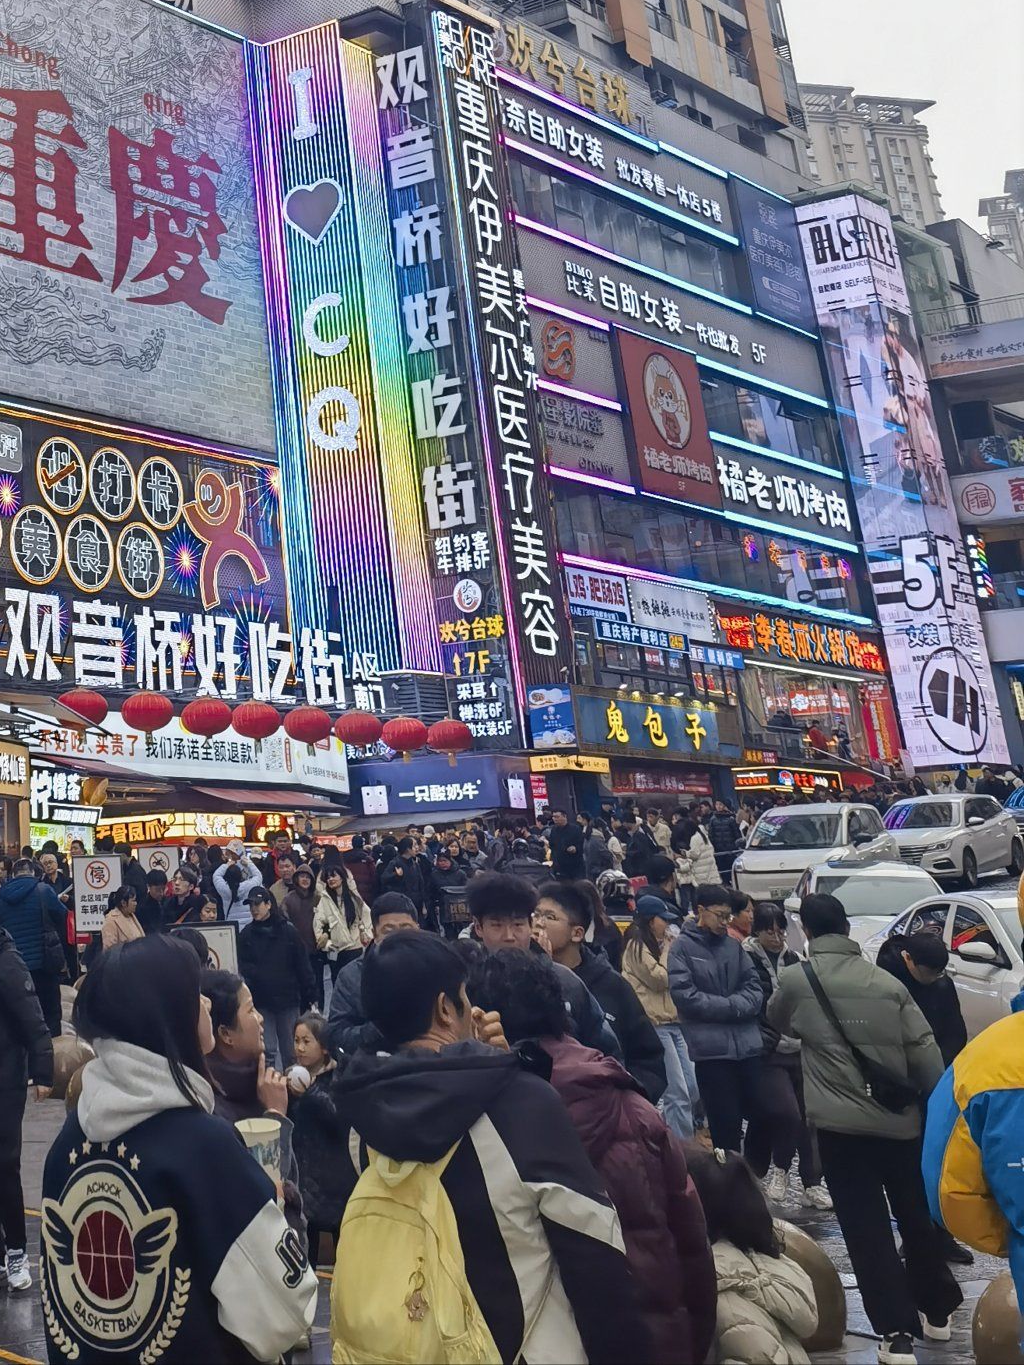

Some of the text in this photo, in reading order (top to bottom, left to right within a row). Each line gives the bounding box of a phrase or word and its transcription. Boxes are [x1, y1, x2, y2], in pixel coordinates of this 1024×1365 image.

[143, 92, 187, 127] qing
[500, 97, 607, 171] 奈自助女装
[565, 260, 593, 280] BIMO
[375, 45, 477, 530] 观音桥好吃街
[751, 342, 767, 365] 5F
[643, 446, 714, 485] 橘老师烤肉
[716, 455, 853, 532] 橘老师烤肉
[21, 518, 152, 580] 美食街
[435, 531, 489, 556] 纽约客
[439, 614, 505, 643] 欢兮台球
[601, 621, 669, 648] 重庆特产便利店
[3, 586, 347, 709] 观音桥好吃街
[464, 650, 491, 674] 7F
[606, 700, 708, 751] 鬼包子
[398, 783, 479, 803] 一只酸奶牛
[86, 1181, 122, 1198] ACHOCK
[72, 1300, 142, 1334] BASKETBALL
